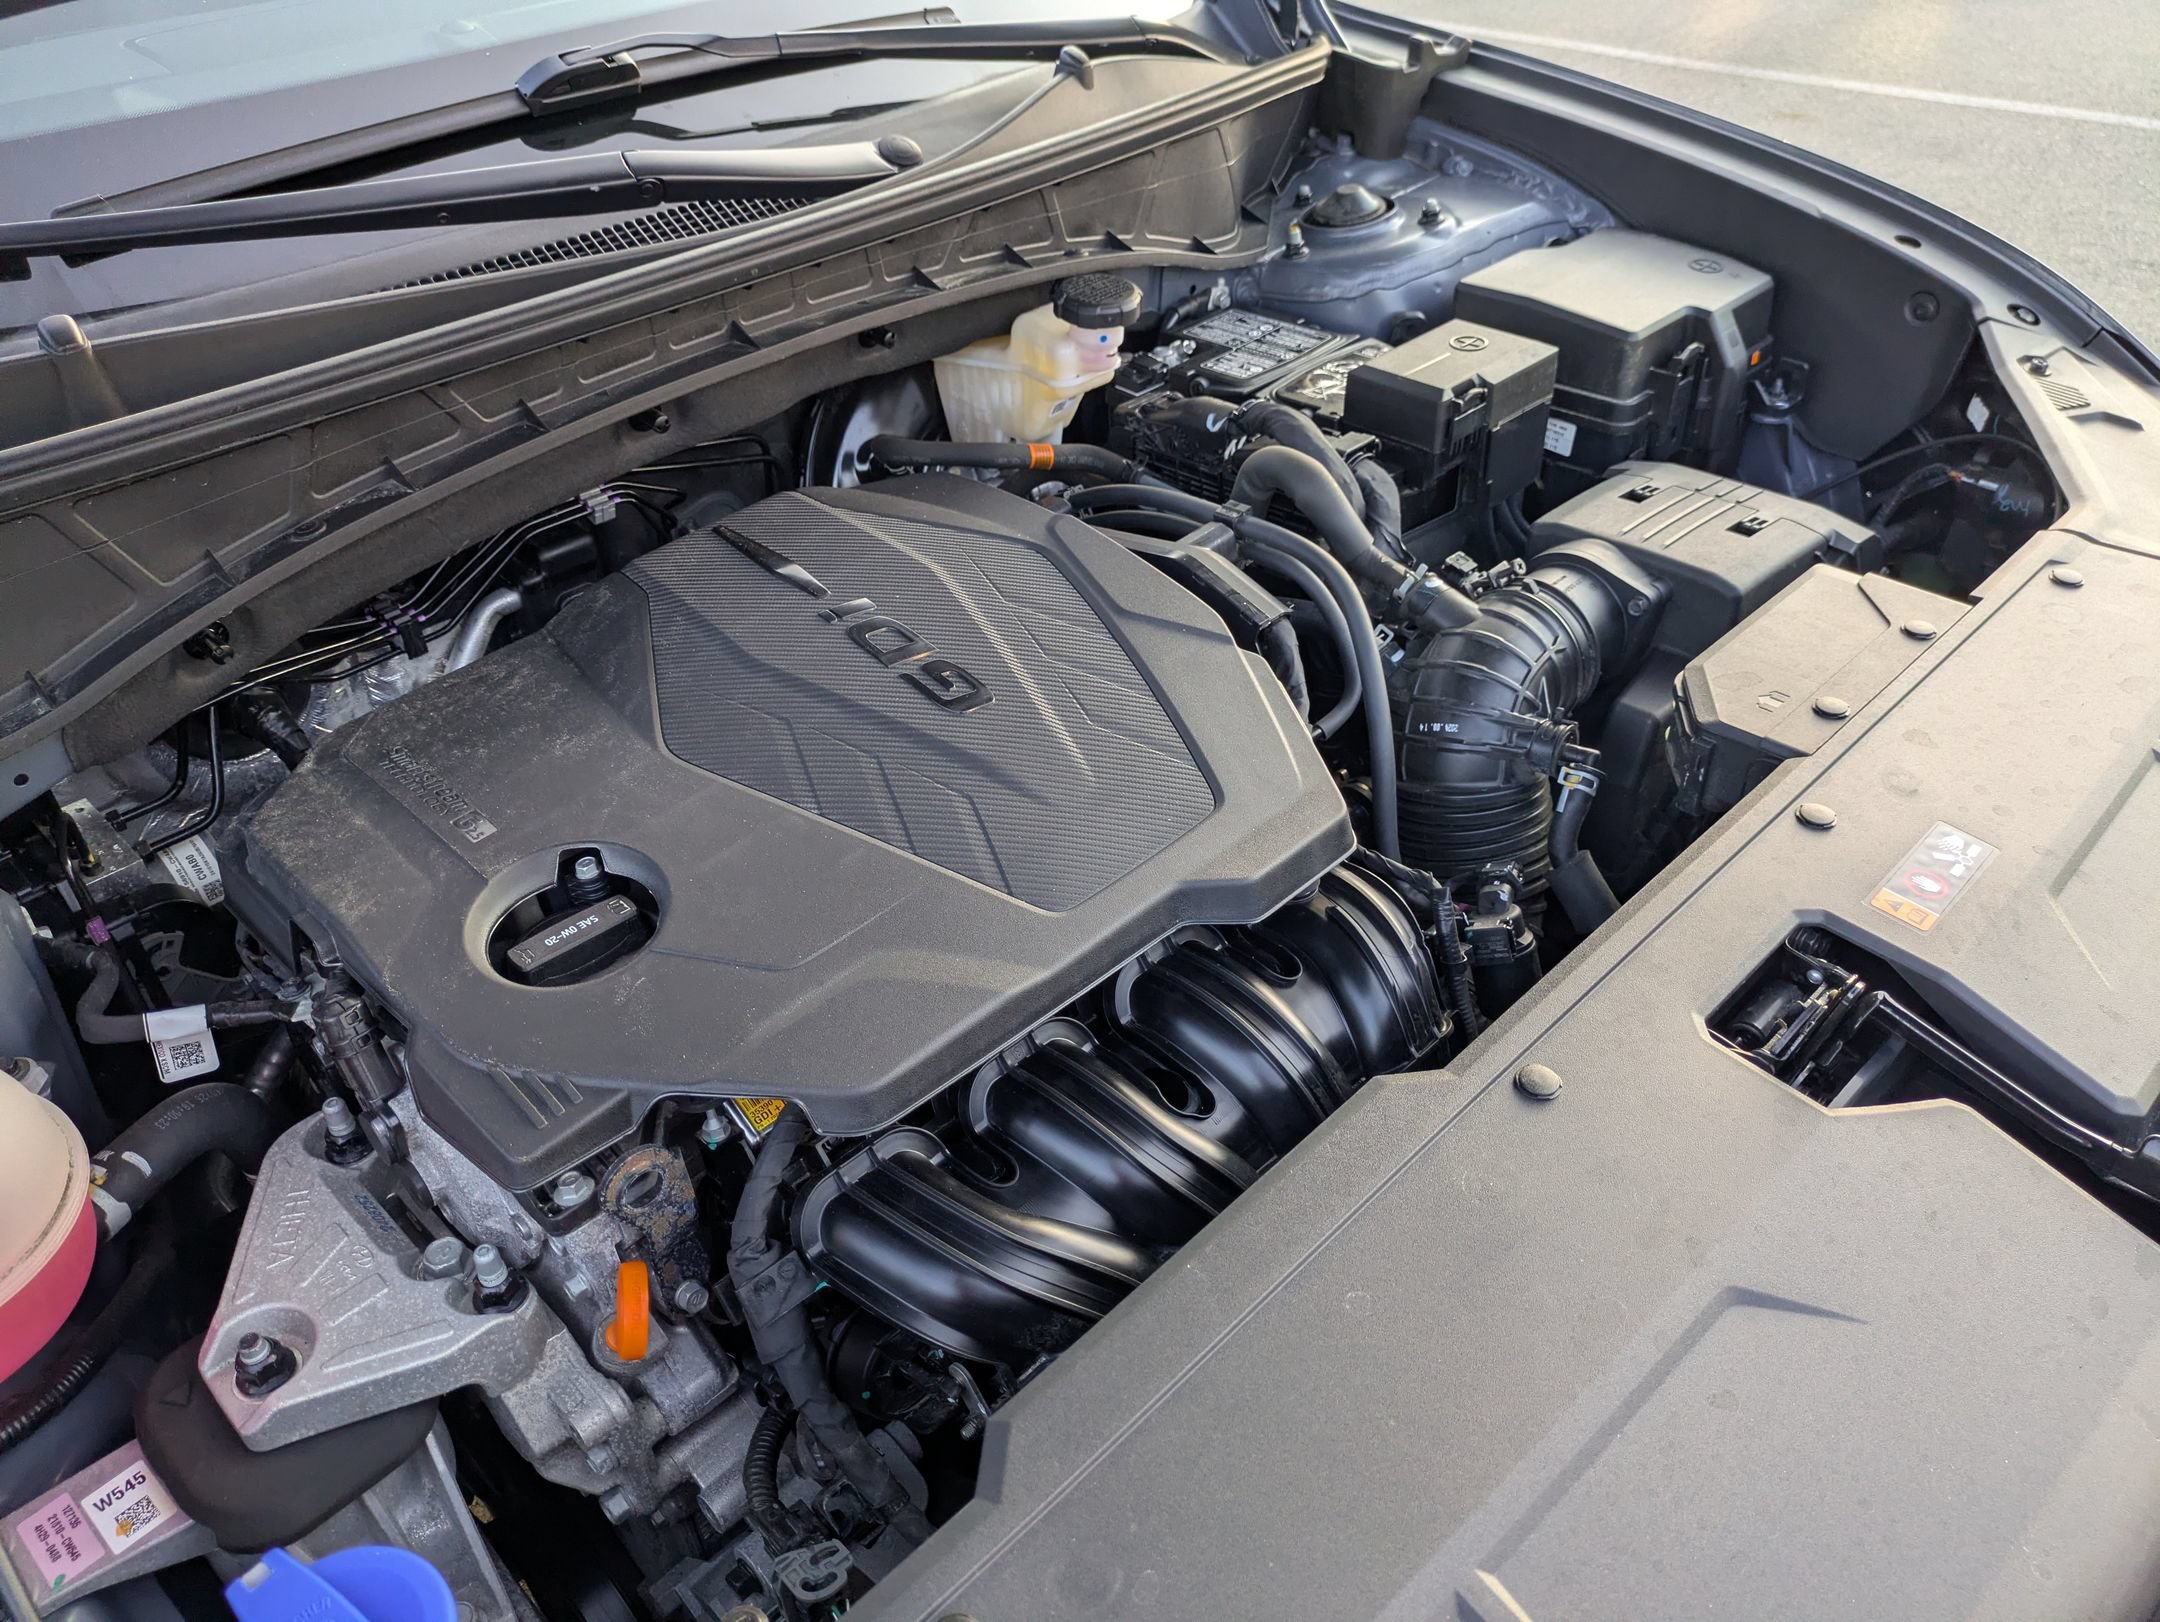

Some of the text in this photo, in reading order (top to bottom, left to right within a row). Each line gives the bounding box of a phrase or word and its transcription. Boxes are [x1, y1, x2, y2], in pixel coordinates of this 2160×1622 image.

[544, 915, 599, 946] SAE 0W-20
[92, 1470, 147, 1513] W545
